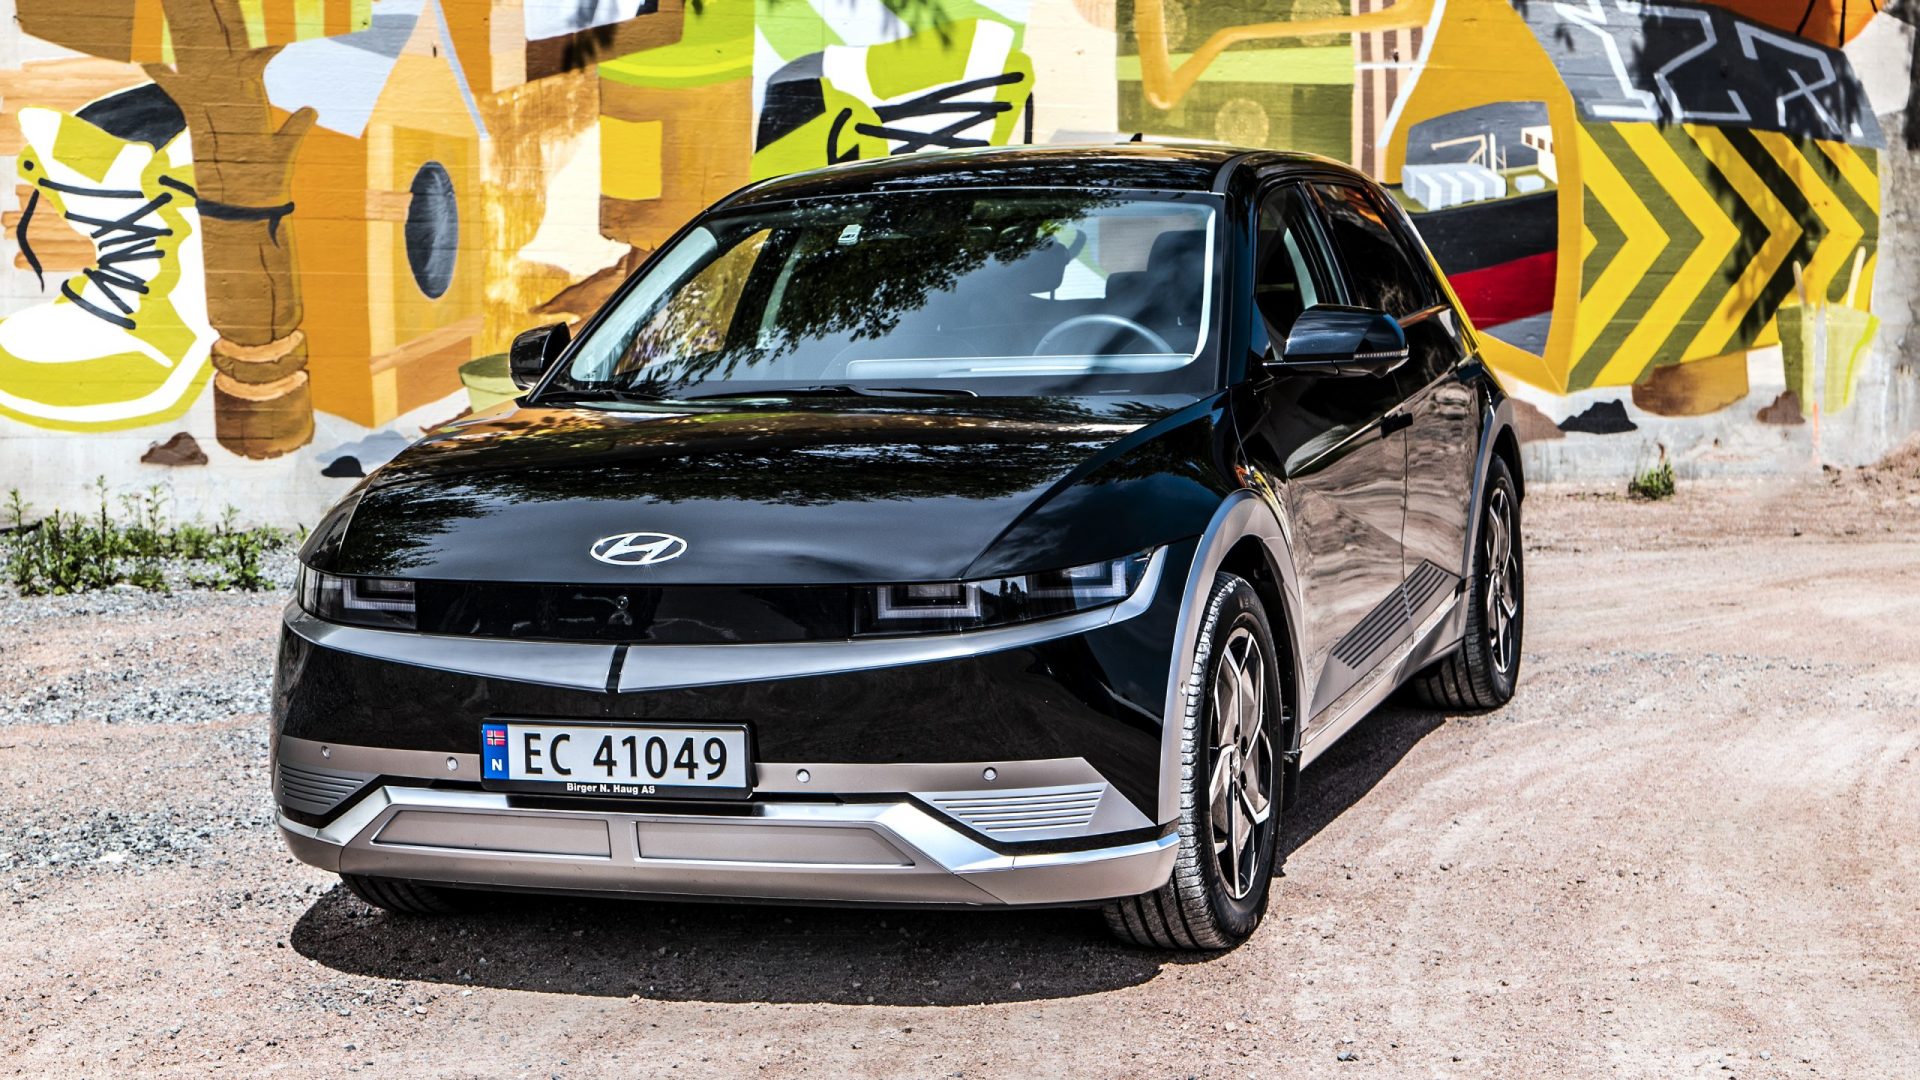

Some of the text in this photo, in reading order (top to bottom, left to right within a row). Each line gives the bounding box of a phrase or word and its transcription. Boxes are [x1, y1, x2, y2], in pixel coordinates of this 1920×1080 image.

[524, 732, 728, 780] EC 41049
[491, 758, 503, 772] N
[566, 782, 656, 795] Birger N. Haug AS
